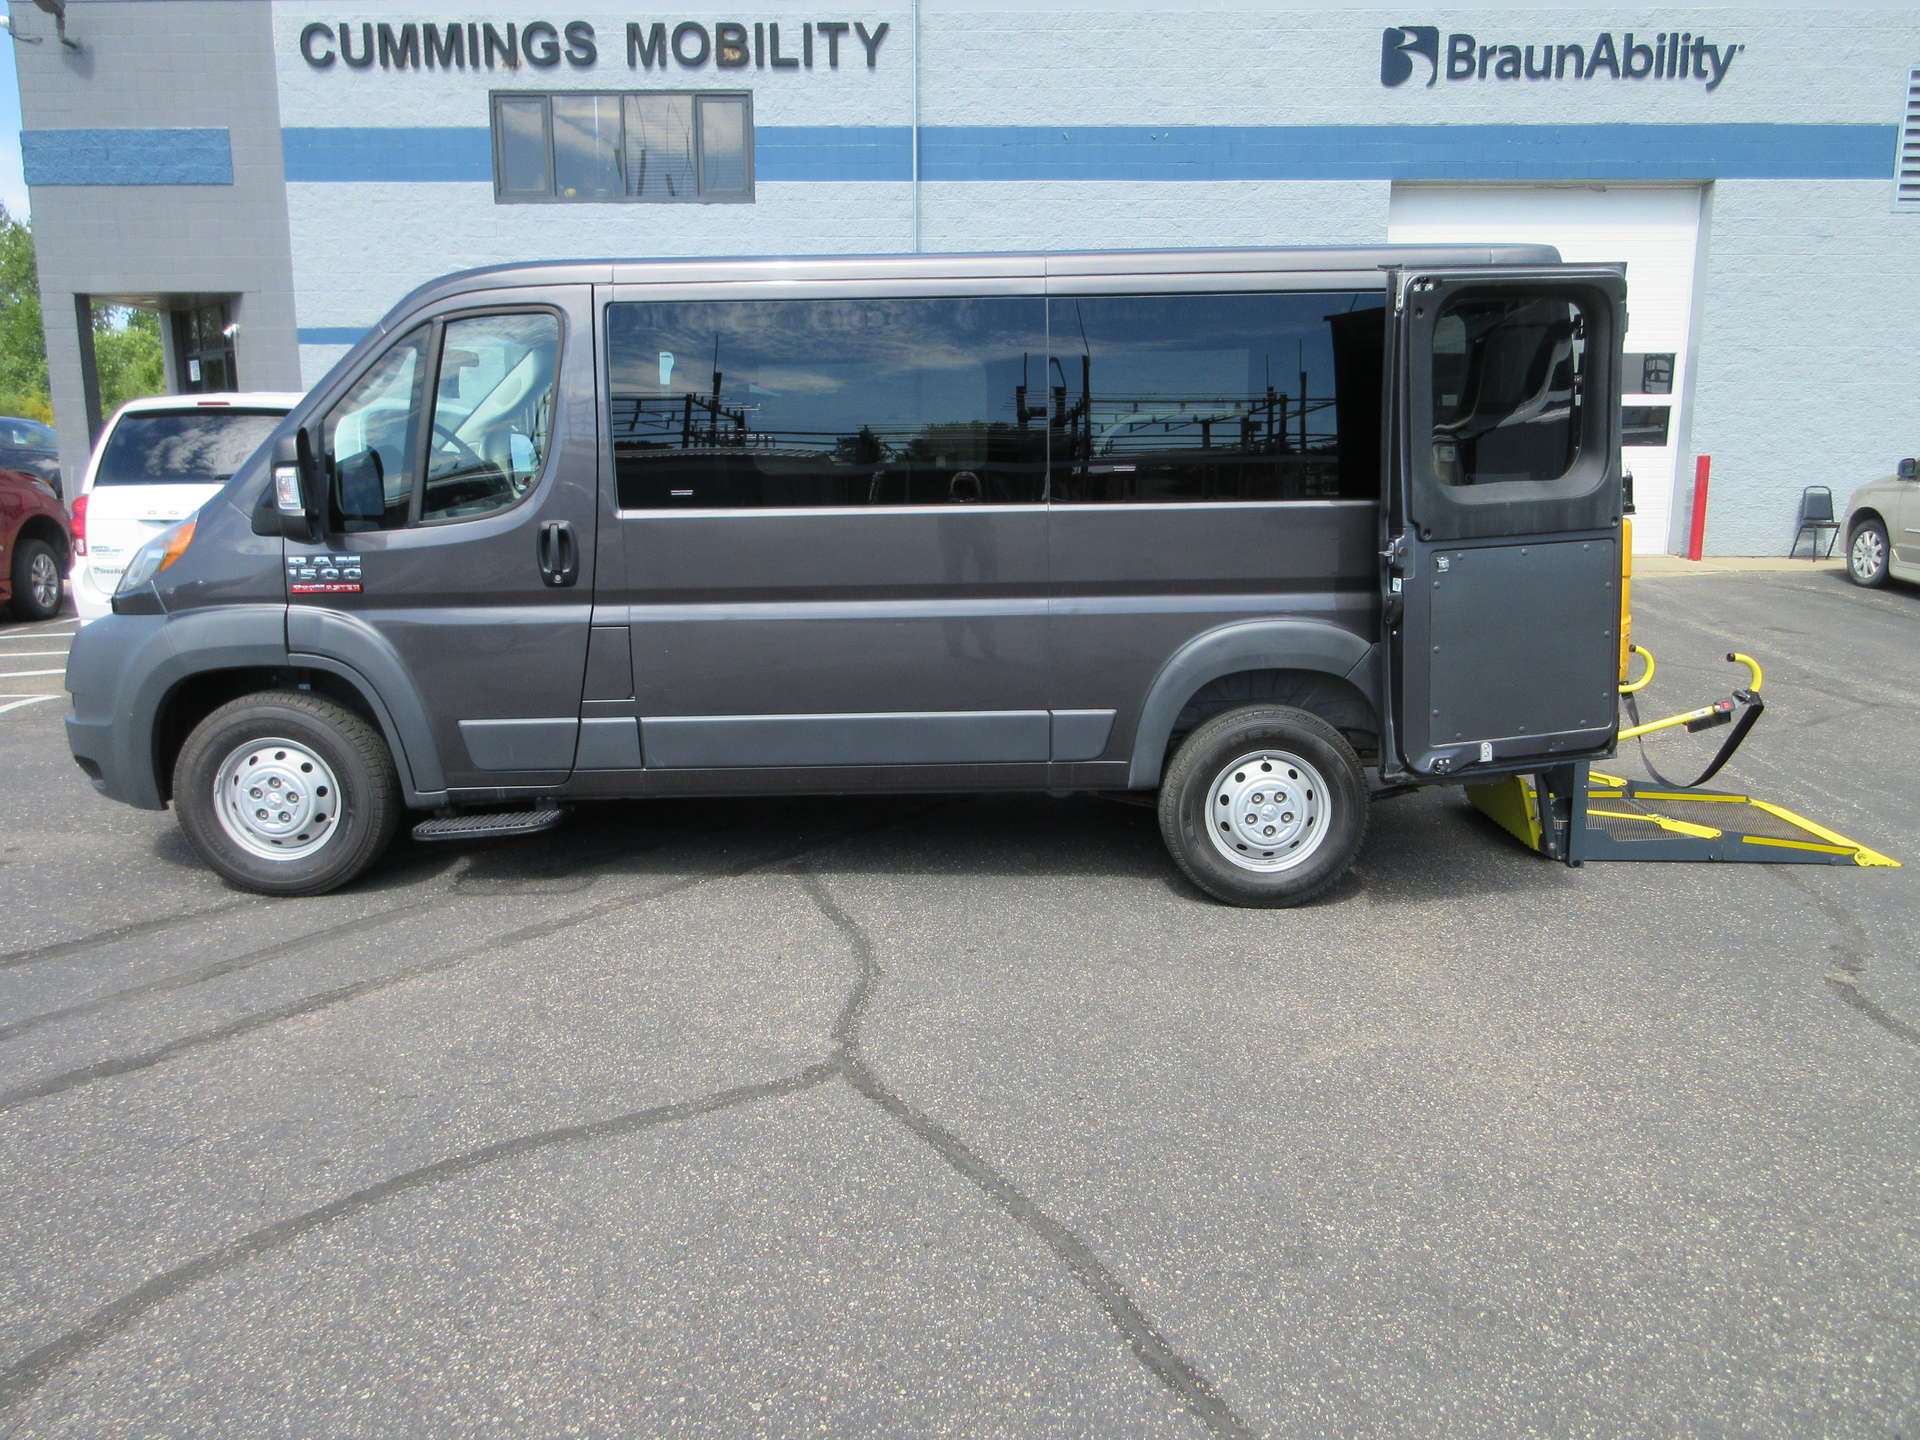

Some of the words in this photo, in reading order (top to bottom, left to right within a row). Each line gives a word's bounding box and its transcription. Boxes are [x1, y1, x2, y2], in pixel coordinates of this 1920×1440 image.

[300, 20, 598, 68] CUMMINGS
[626, 21, 889, 68] MOBILITY
[1446, 32, 1738, 91] BraunAbility
[287, 555, 361, 568] RAM
[288, 567, 363, 580] 1500
